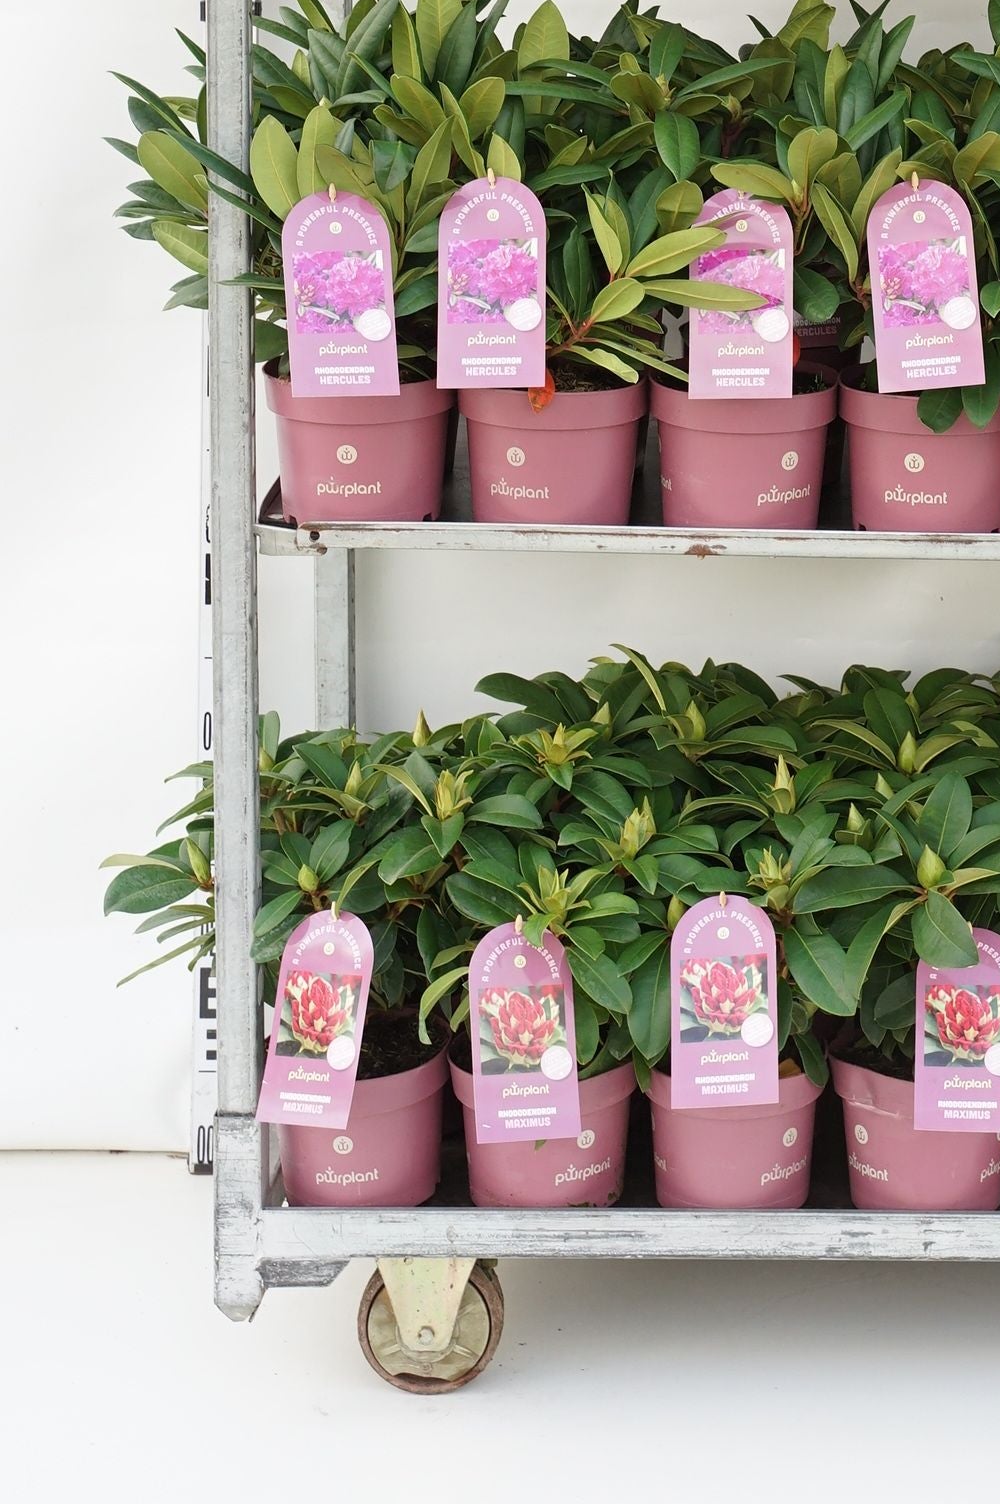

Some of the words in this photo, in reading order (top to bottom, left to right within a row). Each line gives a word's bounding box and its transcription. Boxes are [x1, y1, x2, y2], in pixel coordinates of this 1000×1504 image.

[455, 191, 498, 225] POWERFUL
[500, 193, 534, 234] PRESENCE
[882, 193, 922, 230] POWERFUL
[925, 193, 960, 232] PRESENCE
[298, 205, 339, 238] POWERFUL
[342, 206, 378, 246] PRESENCE
[749, 203, 781, 244] PRESENCE
[466, 365, 517, 377] HERCULES
[906, 365, 958, 379] HERCULES
[319, 375, 371, 386] HERCULES
[716, 377, 766, 388] HERCULES
[686, 911, 728, 944] POWERFUL
[731, 911, 764, 949] PRESENCE
[296, 924, 337, 955] POWERFUL
[339, 927, 361, 970] PRESENCE
[484, 937, 524, 974] POWERFUL
[702, 1083, 749, 1096] MAXIMUS
[283, 1101, 324, 1115] MAXIMUS
[943, 1109, 992, 1121] MAXIMUS
[505, 1116, 551, 1129] MAXIMUS
